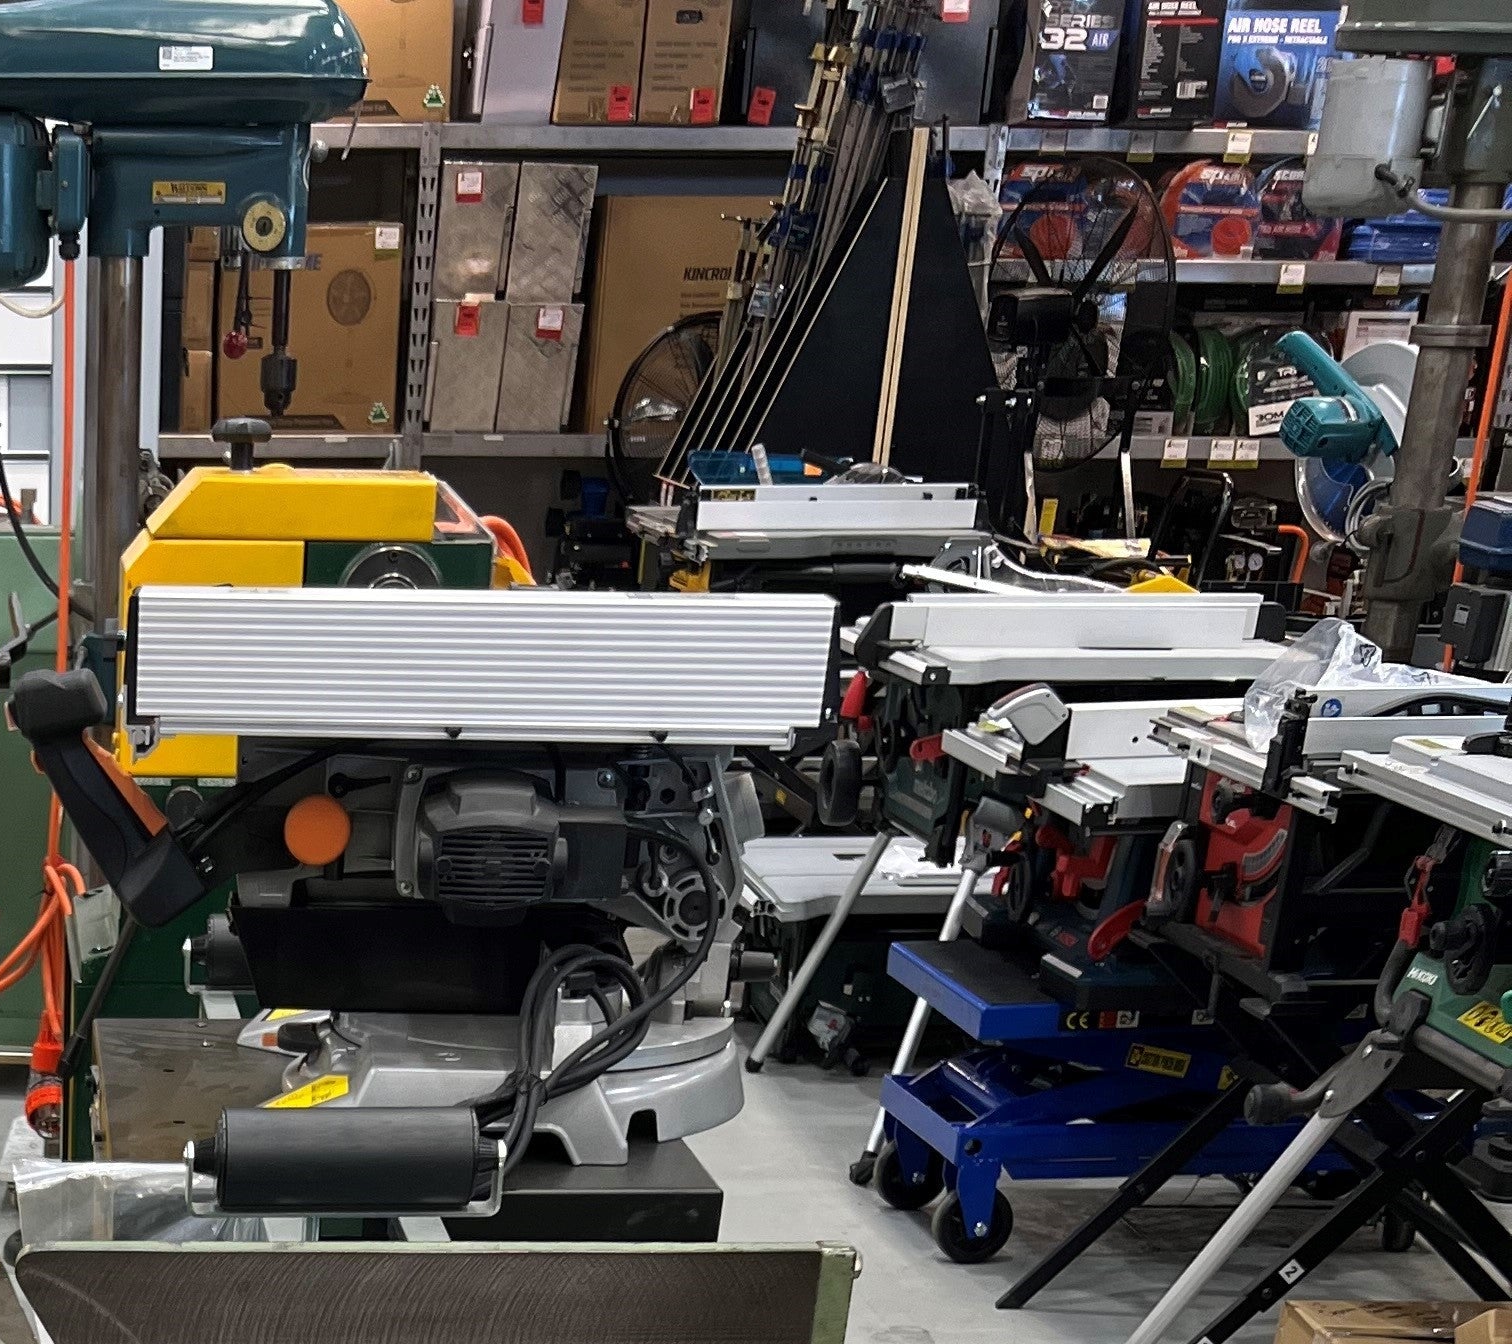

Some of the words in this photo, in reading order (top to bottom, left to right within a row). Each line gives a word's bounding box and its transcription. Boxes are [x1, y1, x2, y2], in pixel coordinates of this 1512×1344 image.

[1045, 14, 1116, 29] SERIES
[1226, 18, 1251, 33] AIR
[1253, 18, 1288, 33] HOSE
[1290, 18, 1322, 33] REEL
[1040, 27, 1088, 51] 32
[1091, 32, 1109, 48] AIR
[683, 267, 732, 280] KINCRO
[1285, 1266, 1298, 1278] 2
